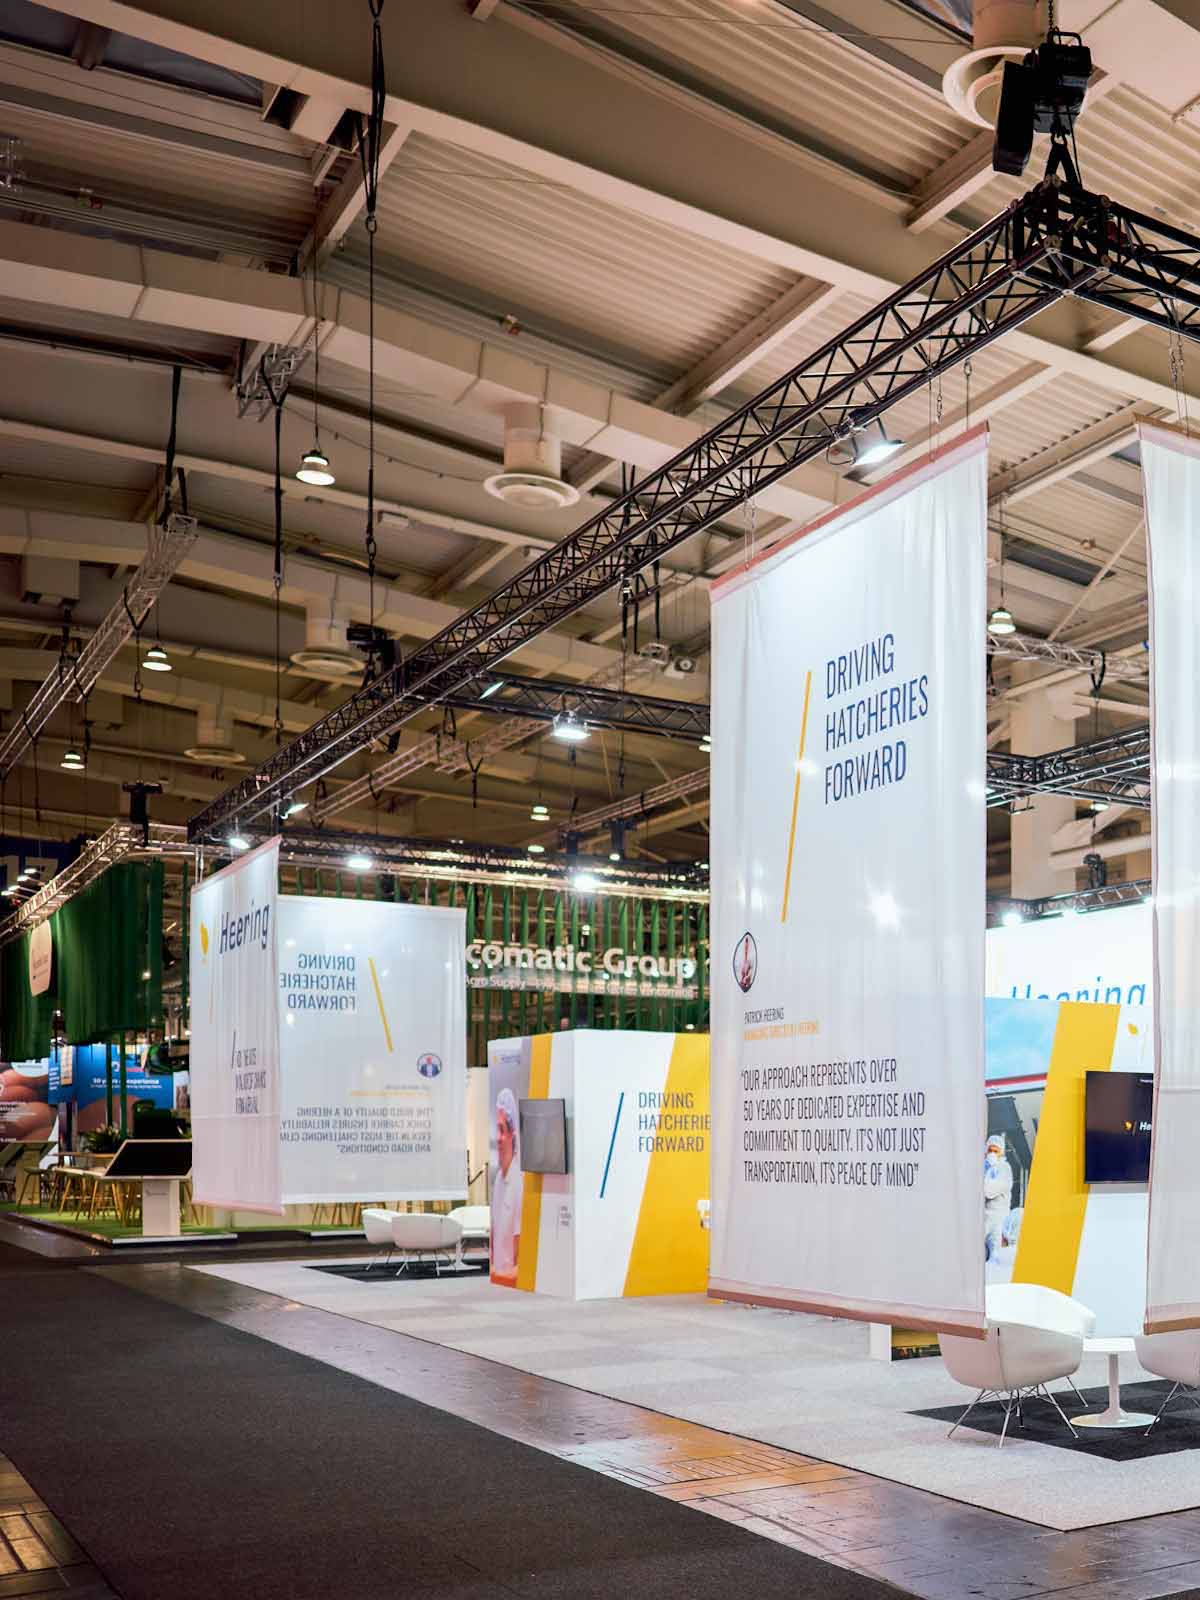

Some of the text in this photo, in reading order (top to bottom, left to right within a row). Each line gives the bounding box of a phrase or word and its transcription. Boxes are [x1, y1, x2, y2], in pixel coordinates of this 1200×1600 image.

[826, 633, 894, 699] DRIVING
[826, 674, 928, 752] HATCHERIES
[825, 740, 906, 804] FORWARD
[219, 900, 270, 954] Heering
[465, 943, 697, 985] comatic Group
[762, 1064, 808, 1090] APPROACH
[810, 1061, 867, 1087] REPRESENTS
[870, 1058, 897, 1084] OVER
[638, 1092, 694, 1109] DRIVING
[743, 1091, 926, 1121] 50 YEARS OF DEDICATED EXPERTISE AND
[638, 1114, 711, 1131] HATCHERIE
[1139, 1121, 1152, 1132] He
[638, 1136, 705, 1152] FORWARD
[743, 1127, 926, 1155] COMMITMENT TO QUALITY. IT'S NOT JUST
[744, 1160, 818, 1185] TRANSPORTATION,
[820, 1161, 835, 1185] IT'S
[837, 1162, 867, 1186] PEACE
[870, 1162, 883, 1186] OF
